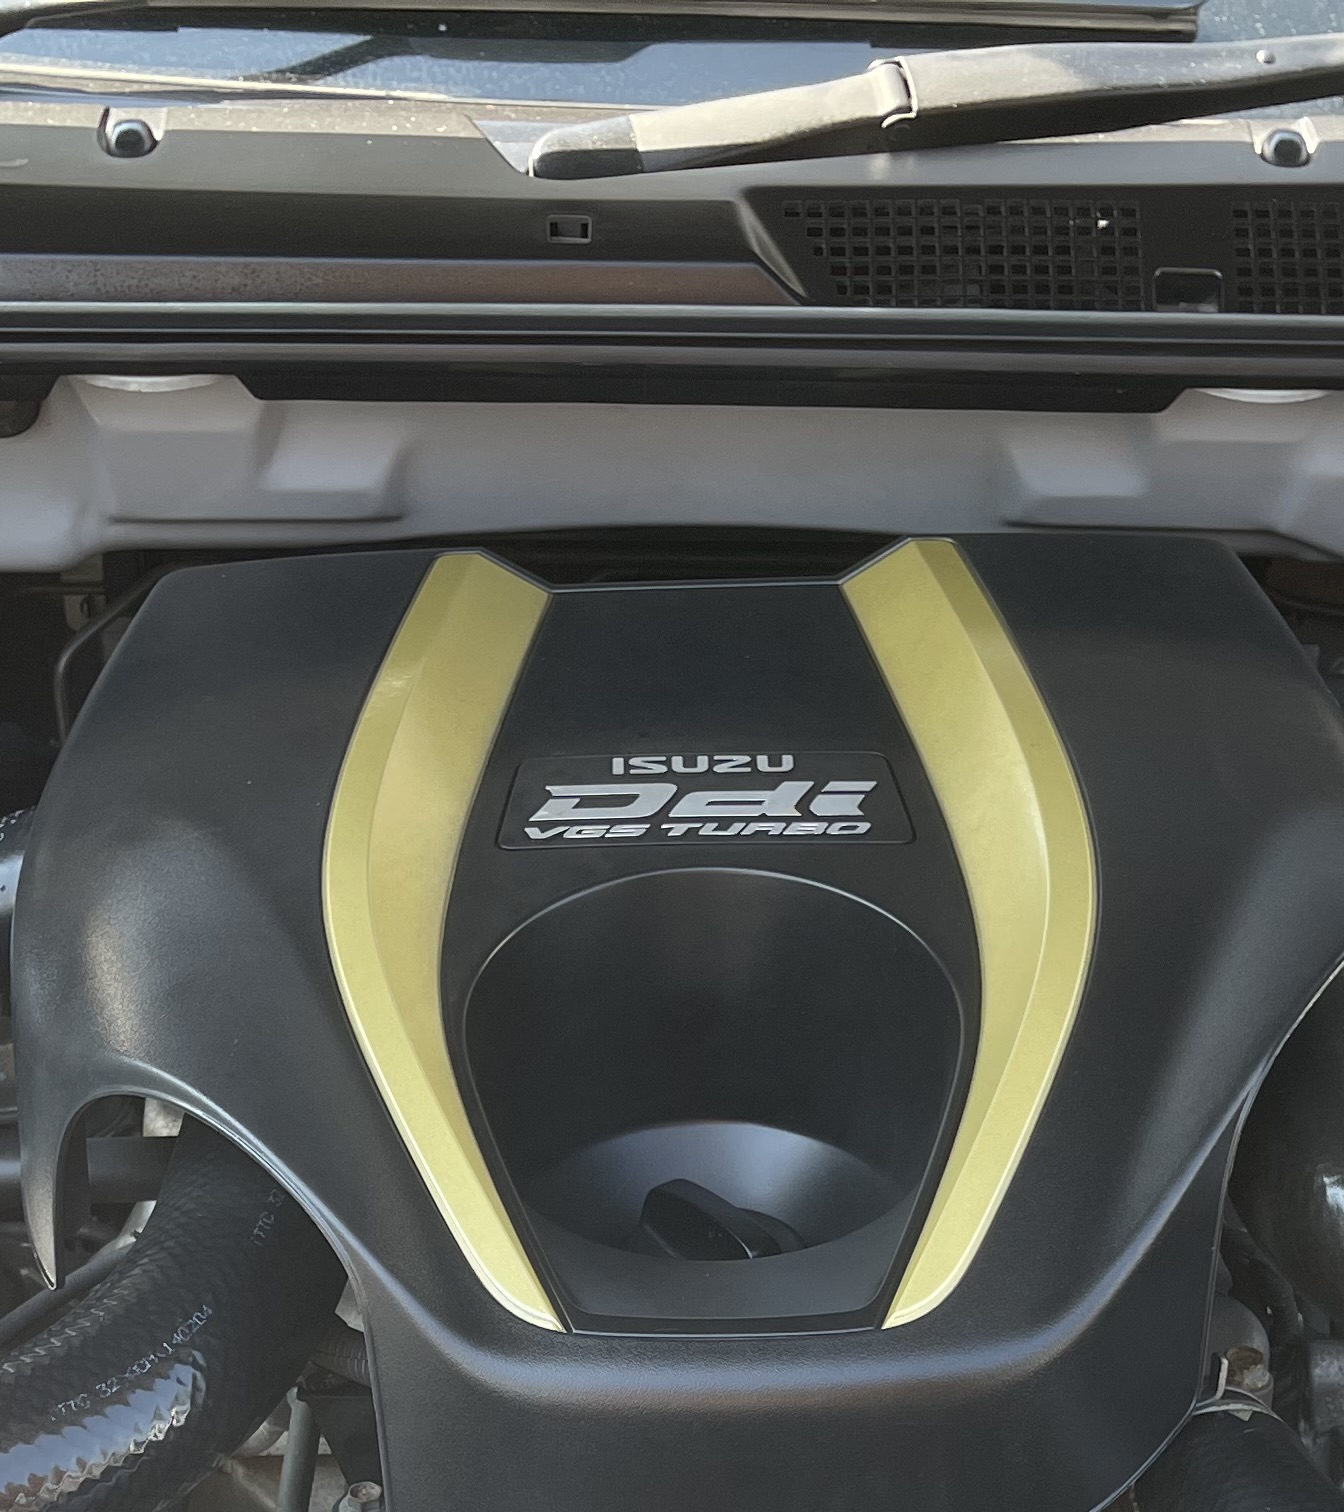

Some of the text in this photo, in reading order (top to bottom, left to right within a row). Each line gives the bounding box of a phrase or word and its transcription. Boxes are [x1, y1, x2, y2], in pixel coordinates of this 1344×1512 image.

[612, 754, 794, 775] ISUZU
[529, 780, 877, 821] Ddi
[524, 821, 872, 840] VGS TURBO
